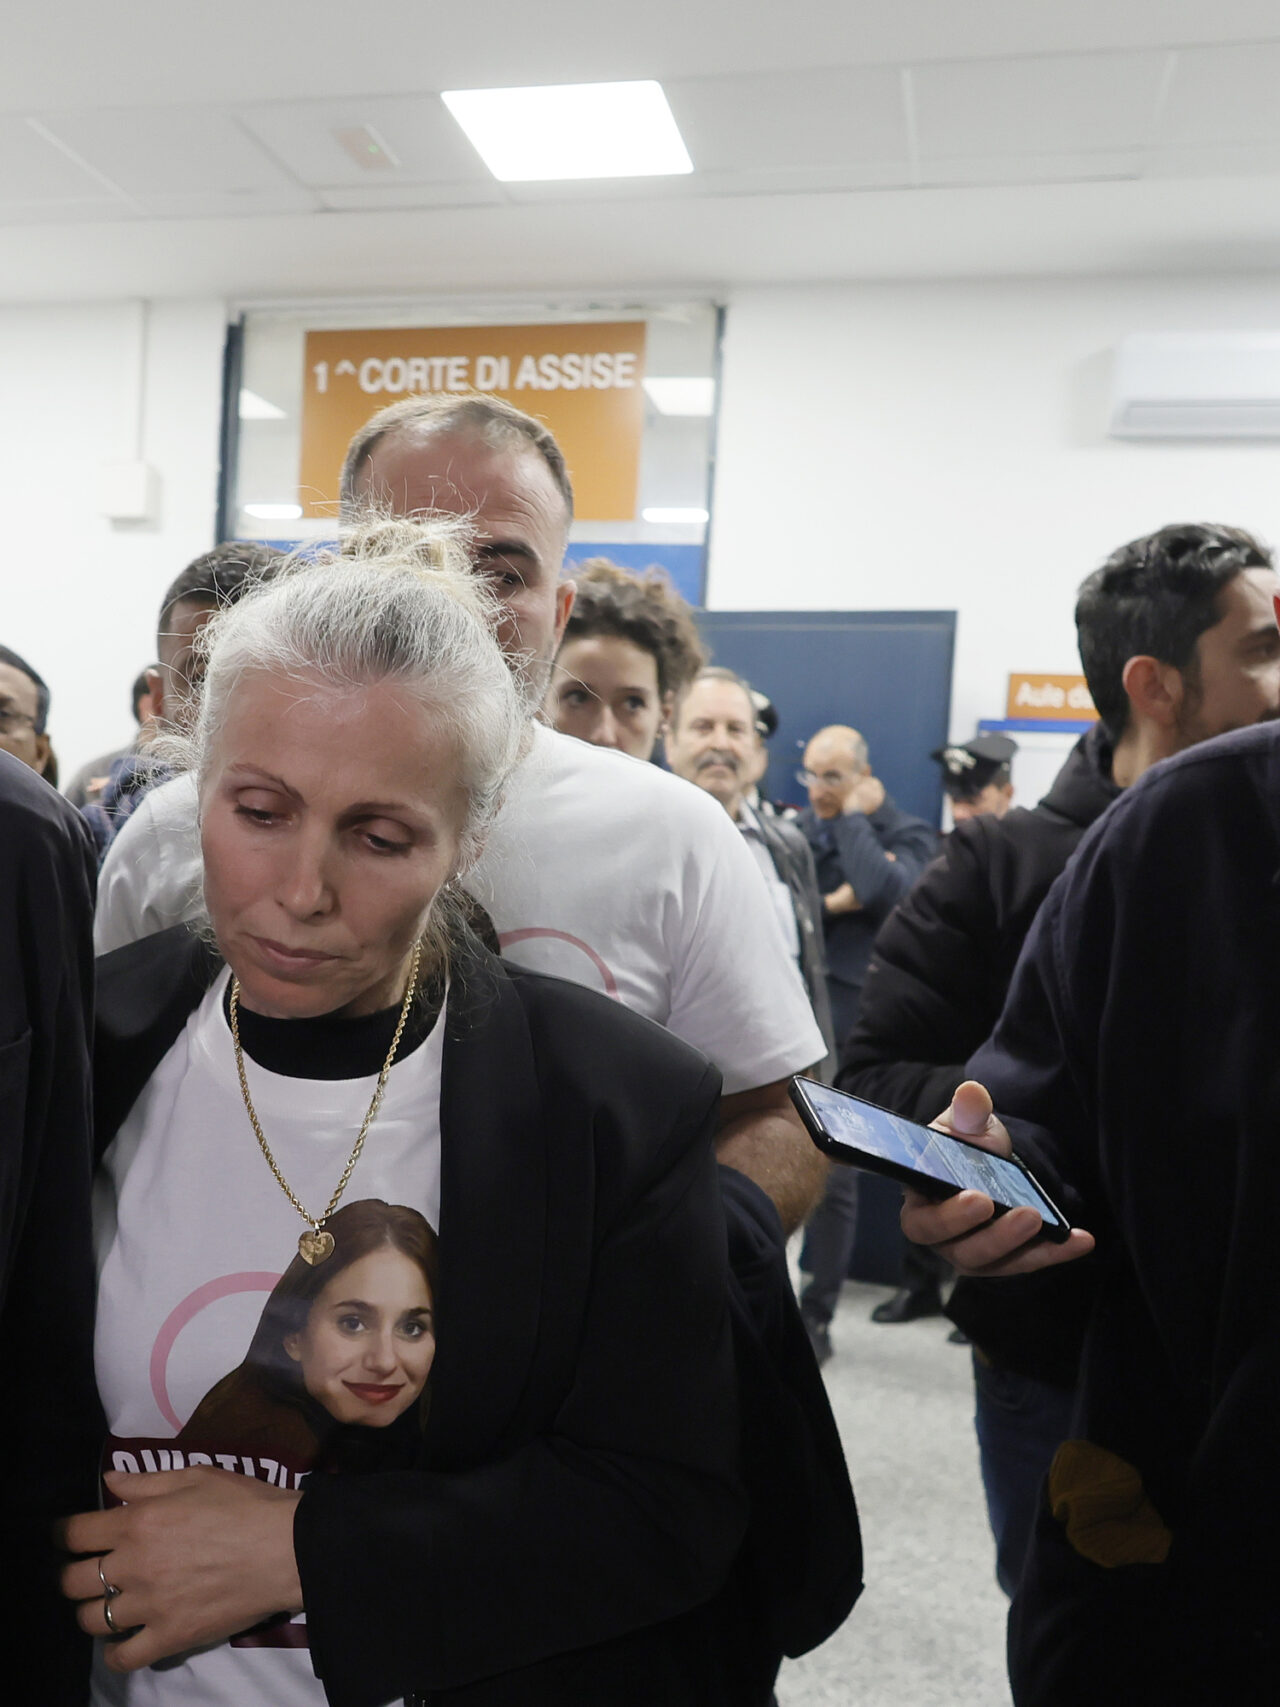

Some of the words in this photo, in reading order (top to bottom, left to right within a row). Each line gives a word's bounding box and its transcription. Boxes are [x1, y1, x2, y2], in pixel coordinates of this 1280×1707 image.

[359, 356, 470, 394] CORTE
[475, 356, 511, 391] DI
[518, 353, 637, 391] ASSISE
